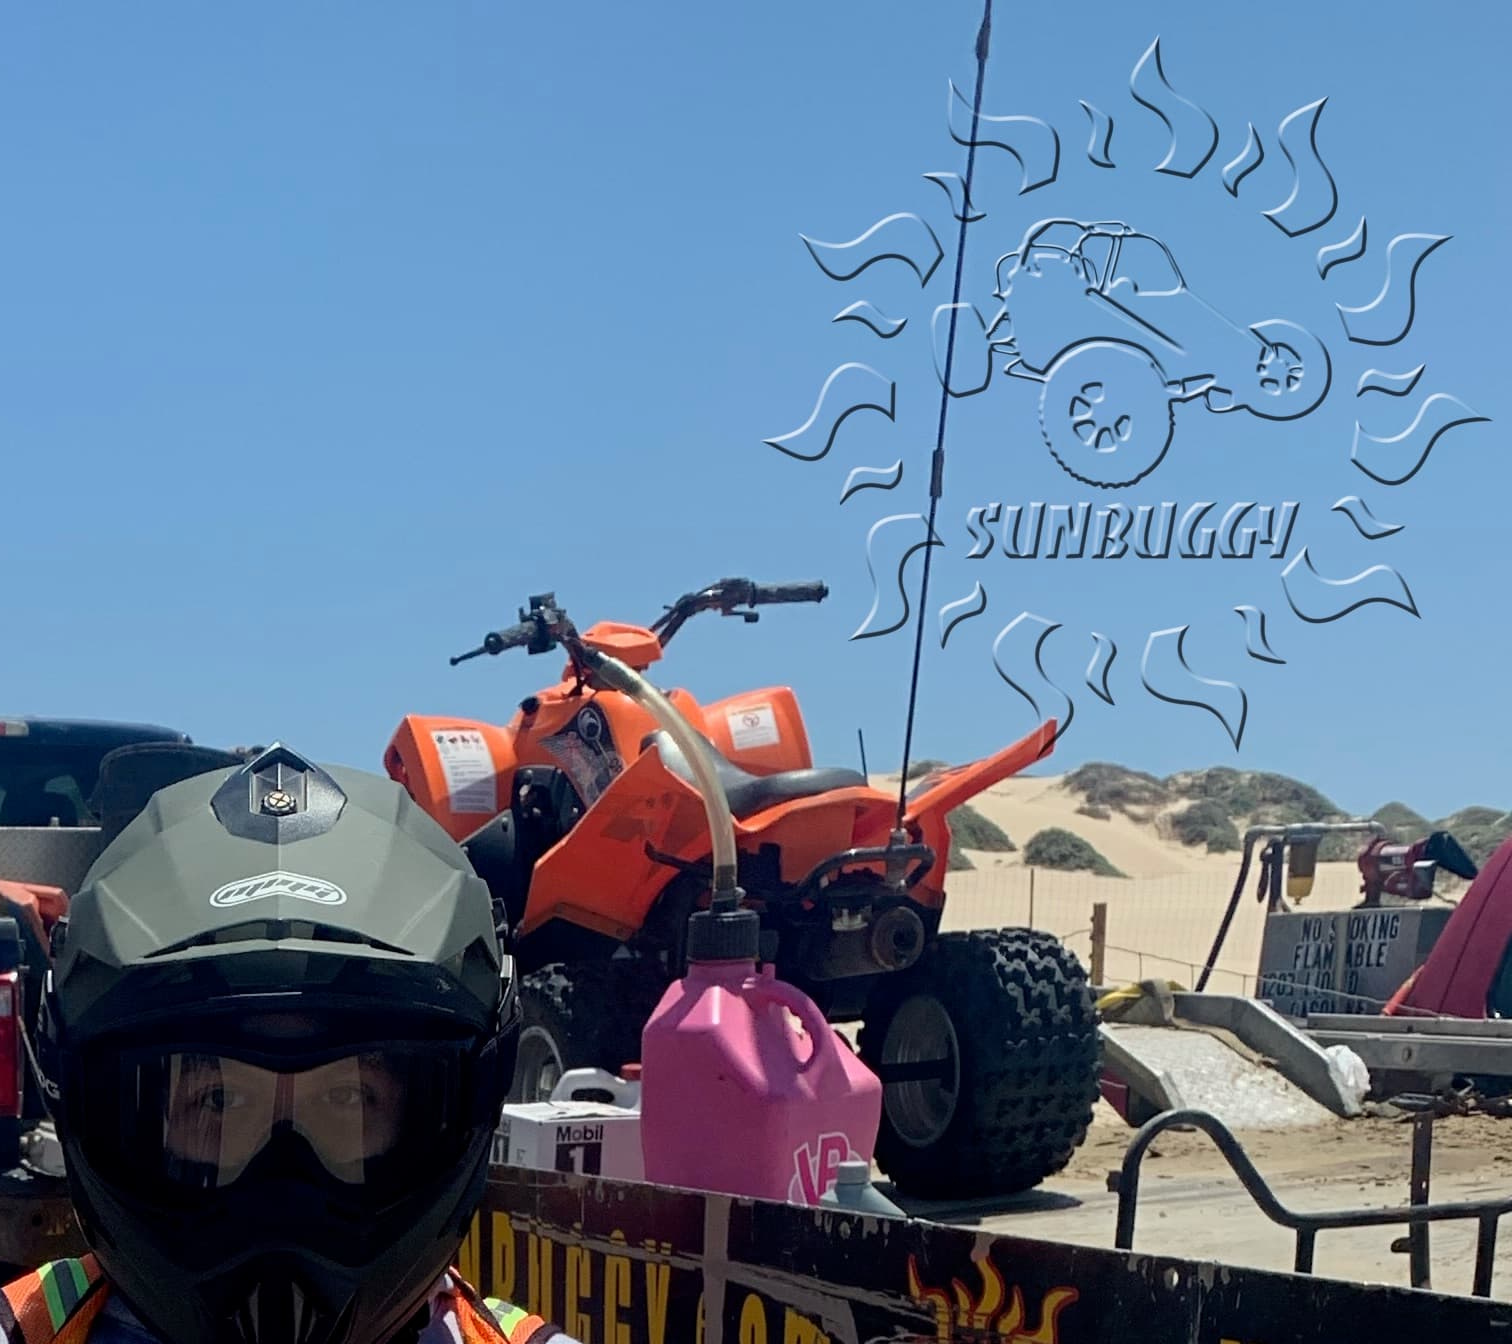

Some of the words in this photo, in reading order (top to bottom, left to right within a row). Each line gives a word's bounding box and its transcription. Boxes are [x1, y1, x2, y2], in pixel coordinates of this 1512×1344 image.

[1301, 917, 1322, 943] NO
[1329, 913, 1400, 943] SOKING
[1293, 942, 1387, 969] FLAMABLE
[1304, 970, 1359, 996] LIQD
[555, 1124, 604, 1142] Mobil
[793, 1131, 850, 1208] VP
